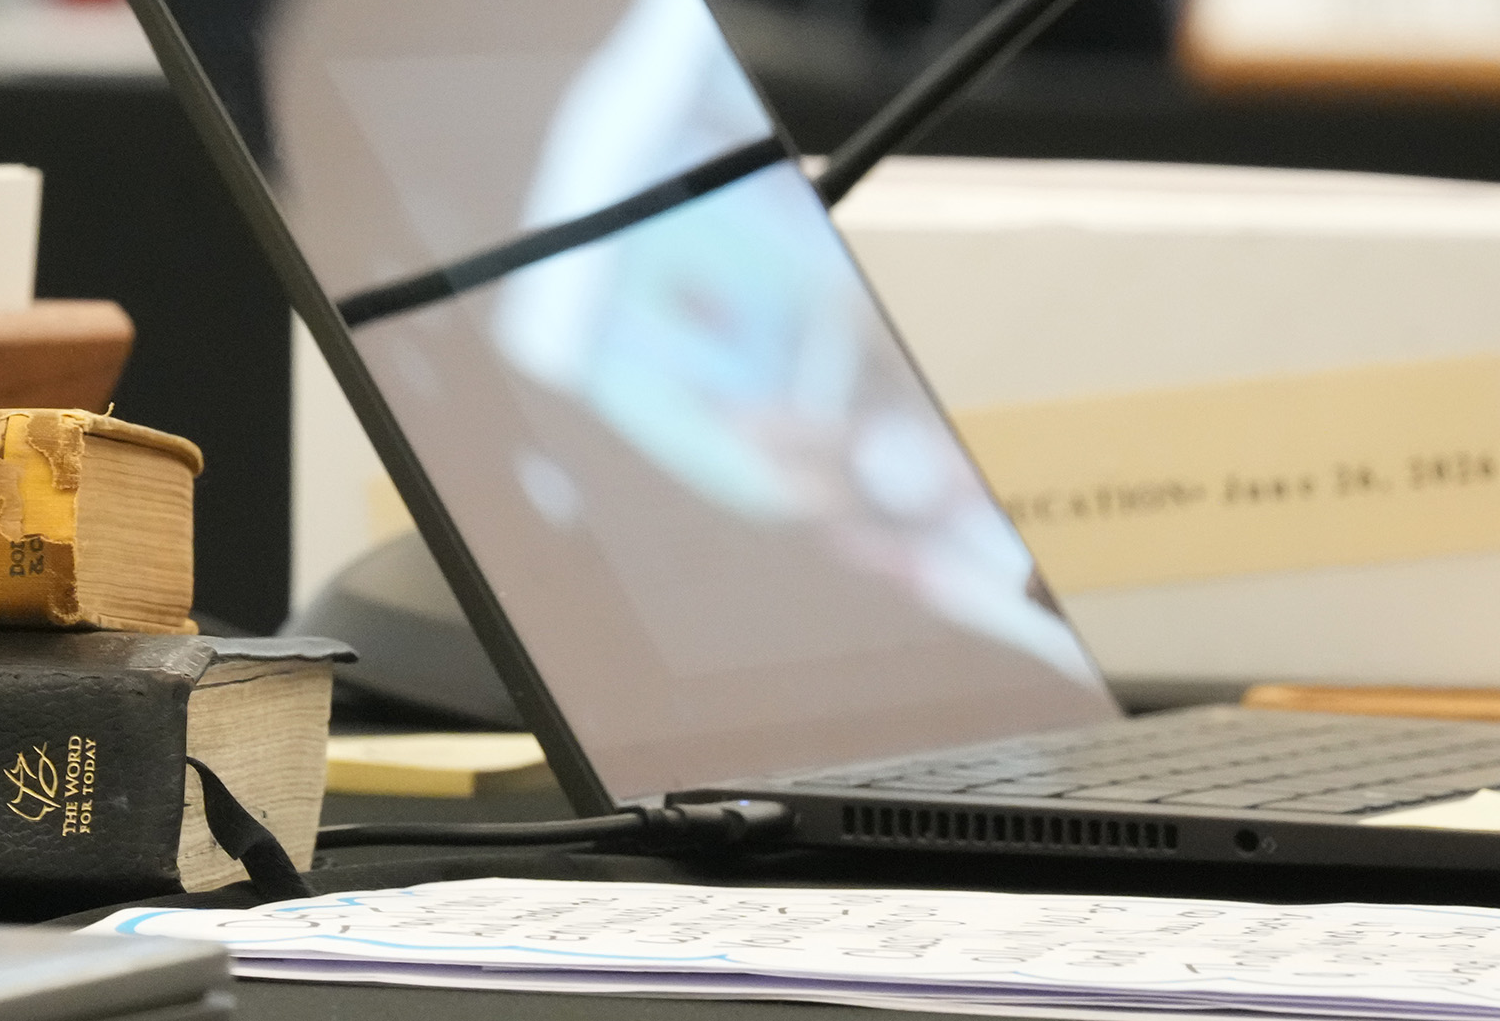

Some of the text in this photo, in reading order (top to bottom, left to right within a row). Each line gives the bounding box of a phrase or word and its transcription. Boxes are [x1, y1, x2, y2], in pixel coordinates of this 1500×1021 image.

[62, 735, 82, 837] THE WORD
[80, 737, 97, 834] FOR TODAY
